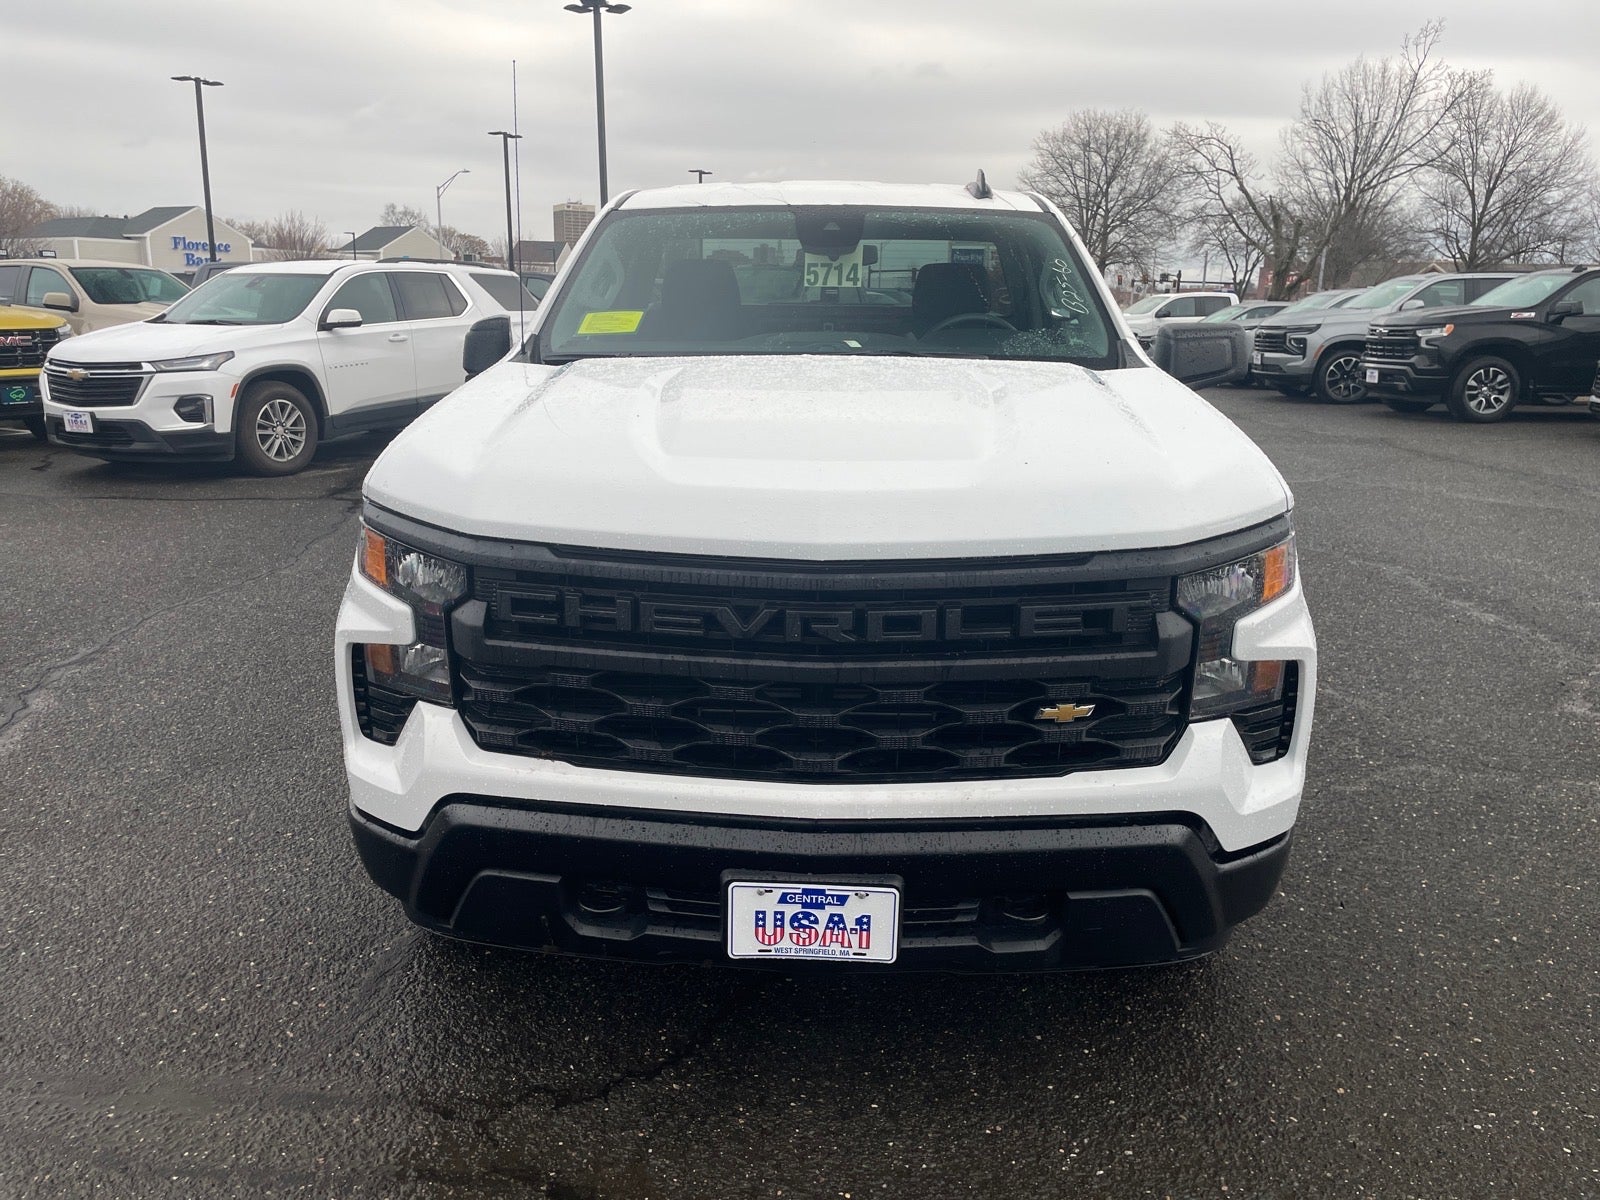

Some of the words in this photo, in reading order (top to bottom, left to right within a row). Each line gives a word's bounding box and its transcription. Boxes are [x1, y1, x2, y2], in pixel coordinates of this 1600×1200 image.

[172, 236, 231, 252] Florece
[184, 253, 222, 266] Ban
[805, 262, 860, 287] 5714
[0, 335, 33, 347] MC
[496, 588, 1151, 642] CHEVROLET
[786, 893, 841, 905] CENTRAL
[754, 910, 872, 949] USA-1
[773, 947, 793, 955] WEST
[794, 947, 838, 957] SPRINGFIELD,
